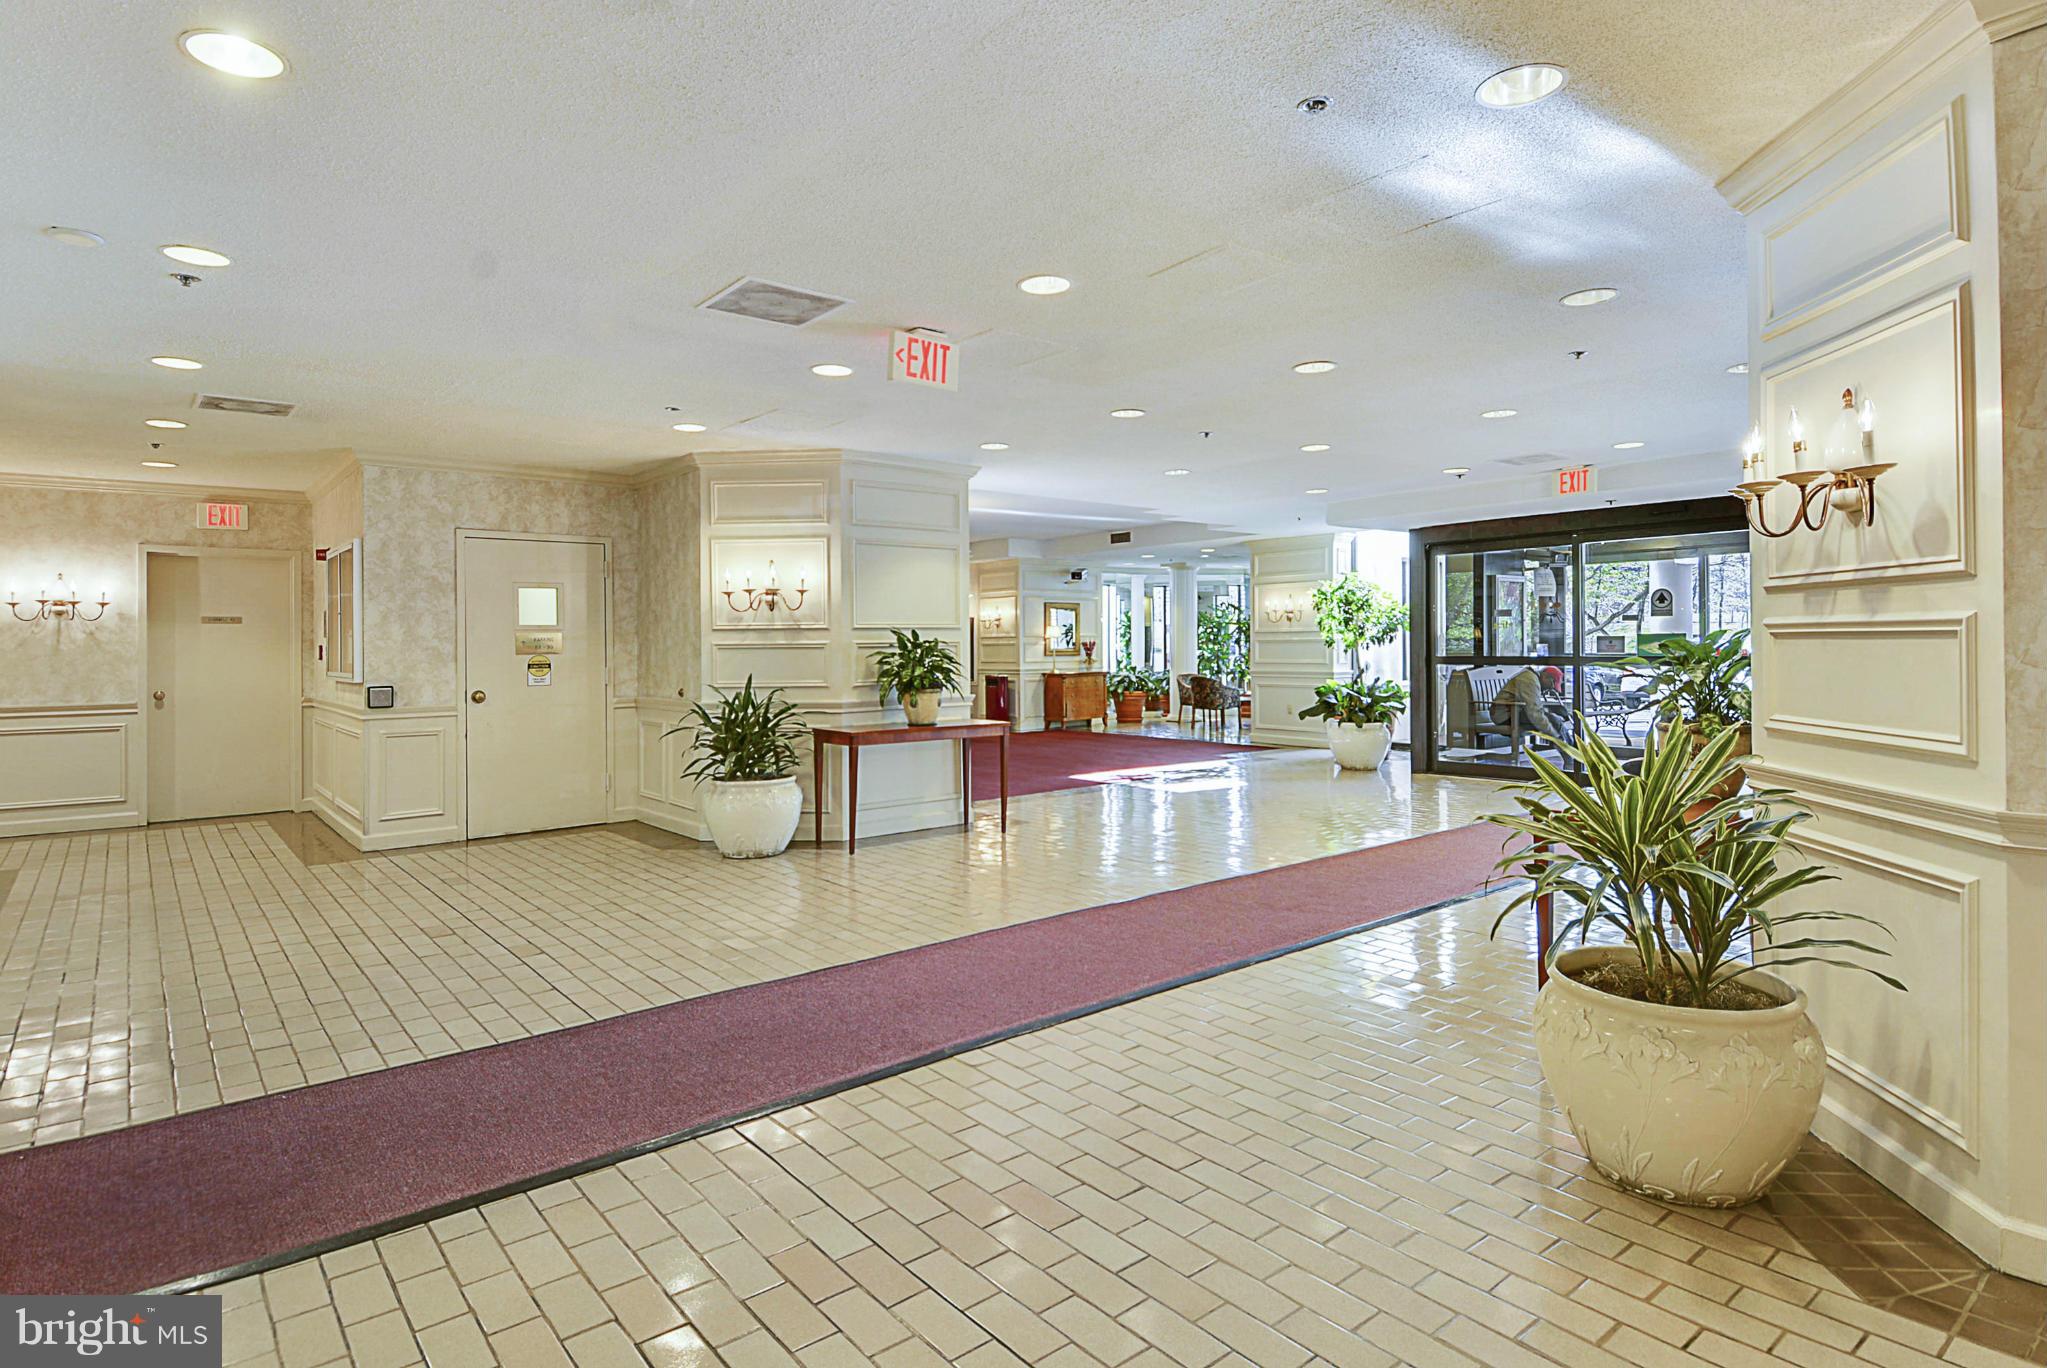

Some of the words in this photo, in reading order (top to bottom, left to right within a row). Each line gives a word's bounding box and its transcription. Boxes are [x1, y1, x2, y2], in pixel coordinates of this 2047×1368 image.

[906, 336, 951, 385] EXIT
[1559, 468, 1589, 494] EXIT
[207, 503, 241, 528] EXIT
